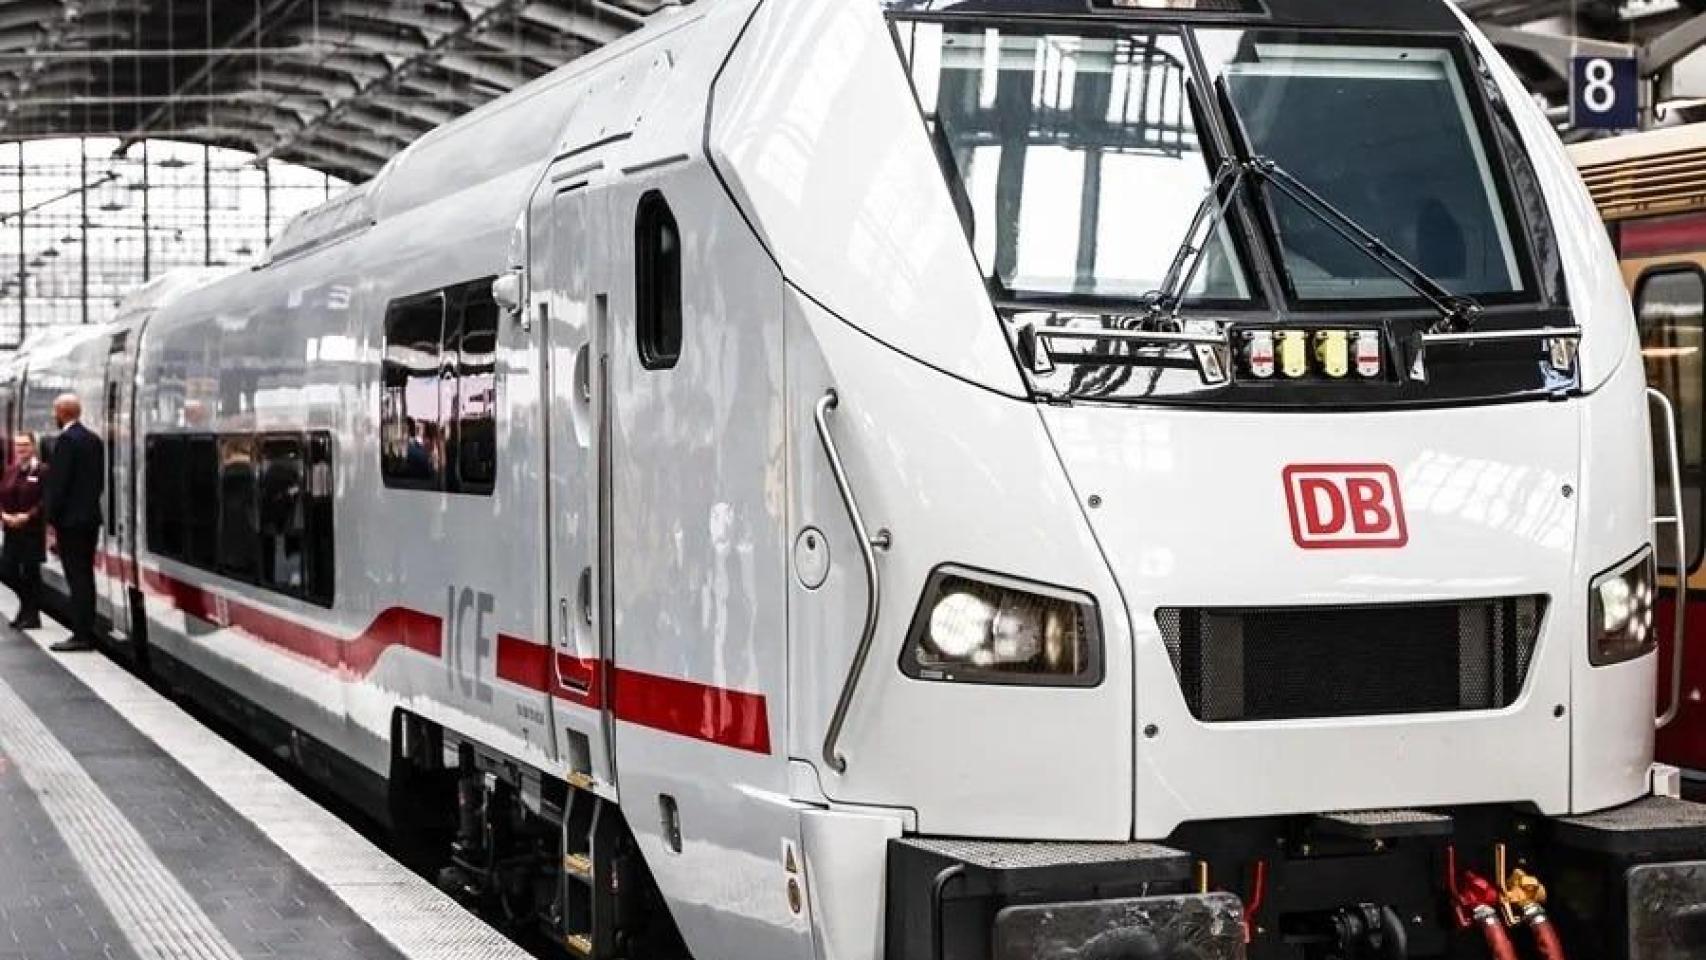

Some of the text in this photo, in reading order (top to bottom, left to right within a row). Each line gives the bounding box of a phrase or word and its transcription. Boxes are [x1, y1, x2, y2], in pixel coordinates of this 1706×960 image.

[1584, 58, 1615, 112] 8
[1299, 478, 1391, 533] DB
[447, 585, 493, 704] ICE
